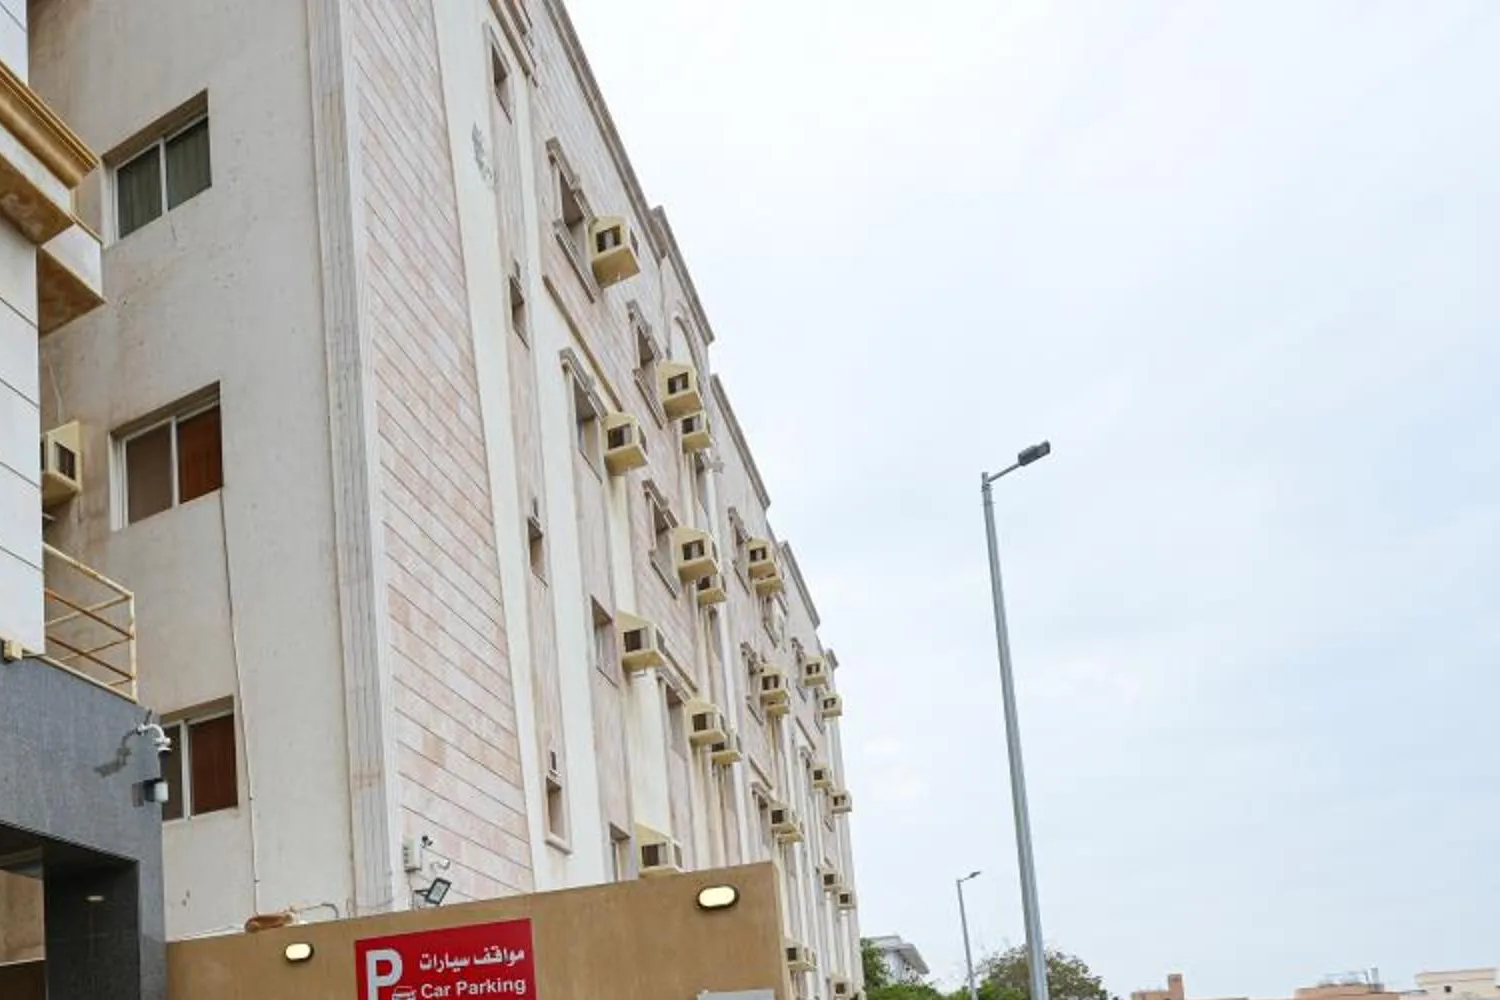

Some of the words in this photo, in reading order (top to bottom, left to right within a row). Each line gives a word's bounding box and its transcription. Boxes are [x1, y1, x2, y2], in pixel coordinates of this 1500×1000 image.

[420, 952, 471, 973] سيارات
[474, 945, 525, 967] مواقف
[421, 983, 451, 999] Car
[456, 978, 526, 996] Parking
